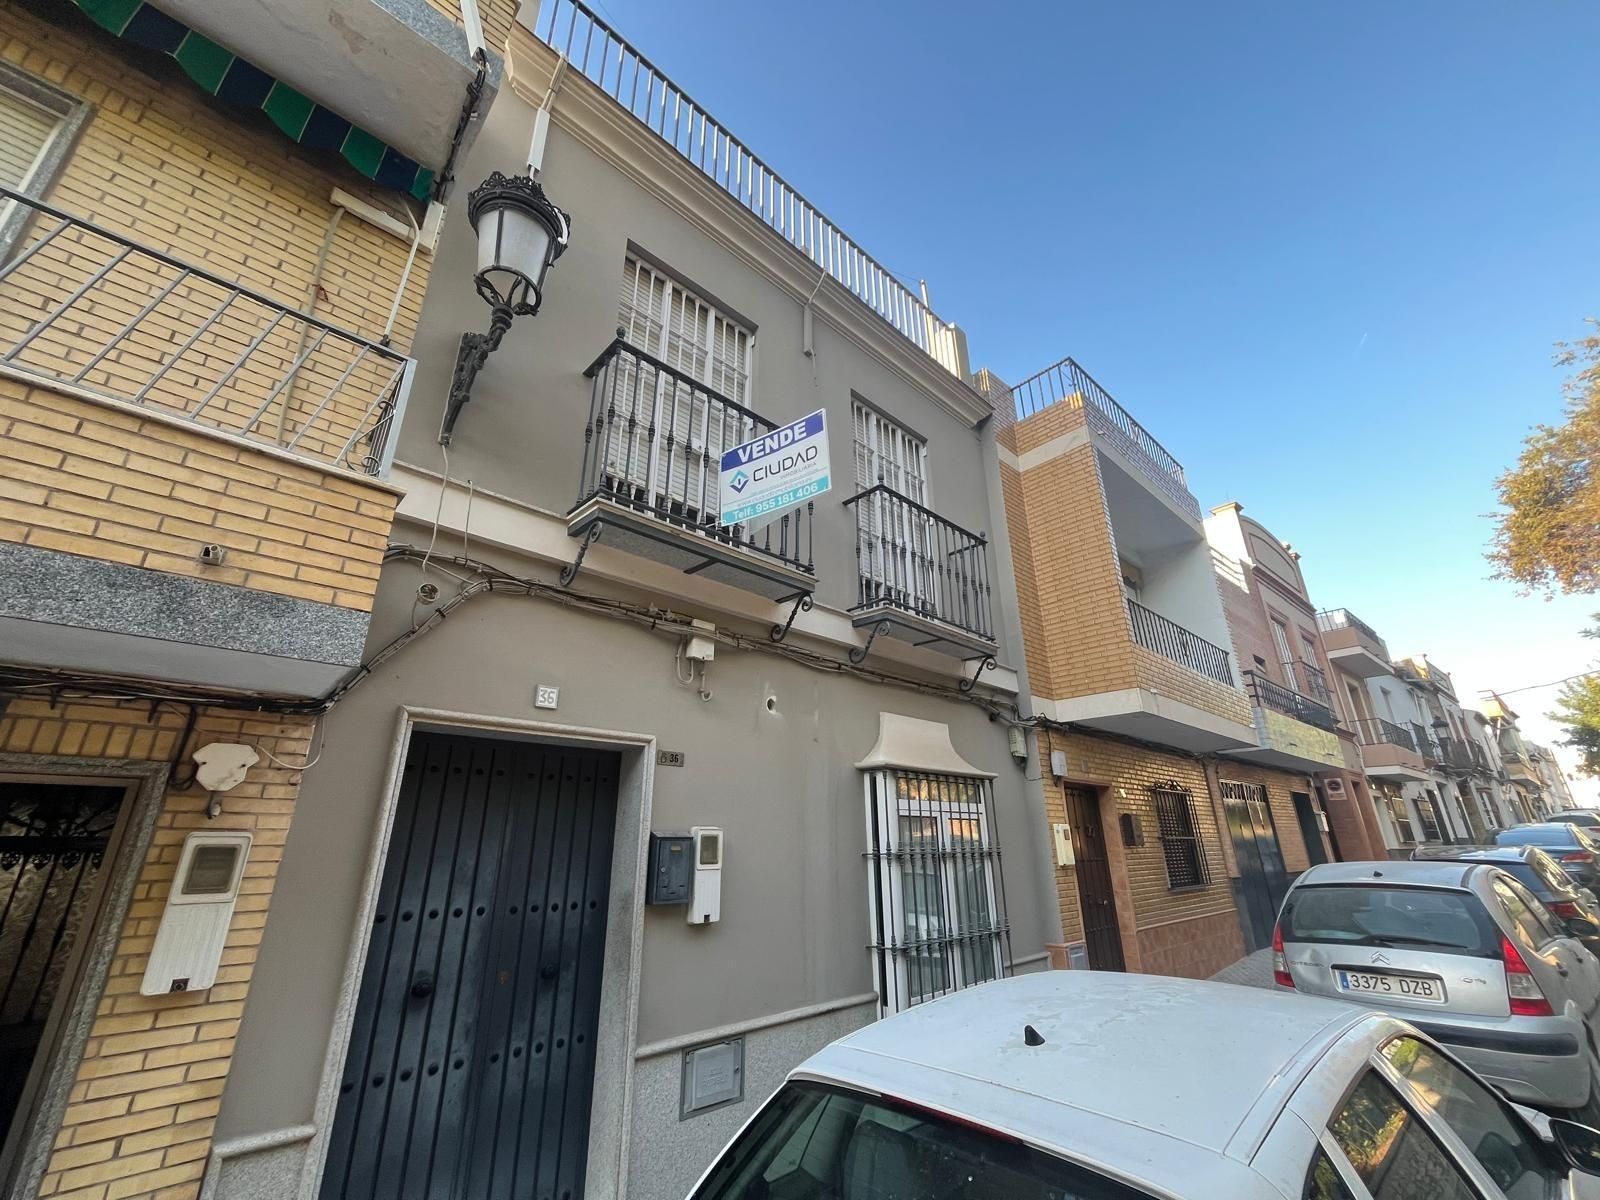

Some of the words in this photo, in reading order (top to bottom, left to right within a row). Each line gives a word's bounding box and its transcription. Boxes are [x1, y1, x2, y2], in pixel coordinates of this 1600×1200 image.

[737, 421, 807, 463] VENDE
[753, 445, 818, 482] CIUDAD
[733, 507, 754, 520] Telf:
[755, 501, 776, 513] 955
[777, 493, 795, 506] 181
[796, 482, 818, 498] 406
[538, 689, 556, 705] 36
[669, 753, 679, 763] 36
[1351, 974, 1391, 991] 3375
[1399, 979, 1433, 996] DZB
